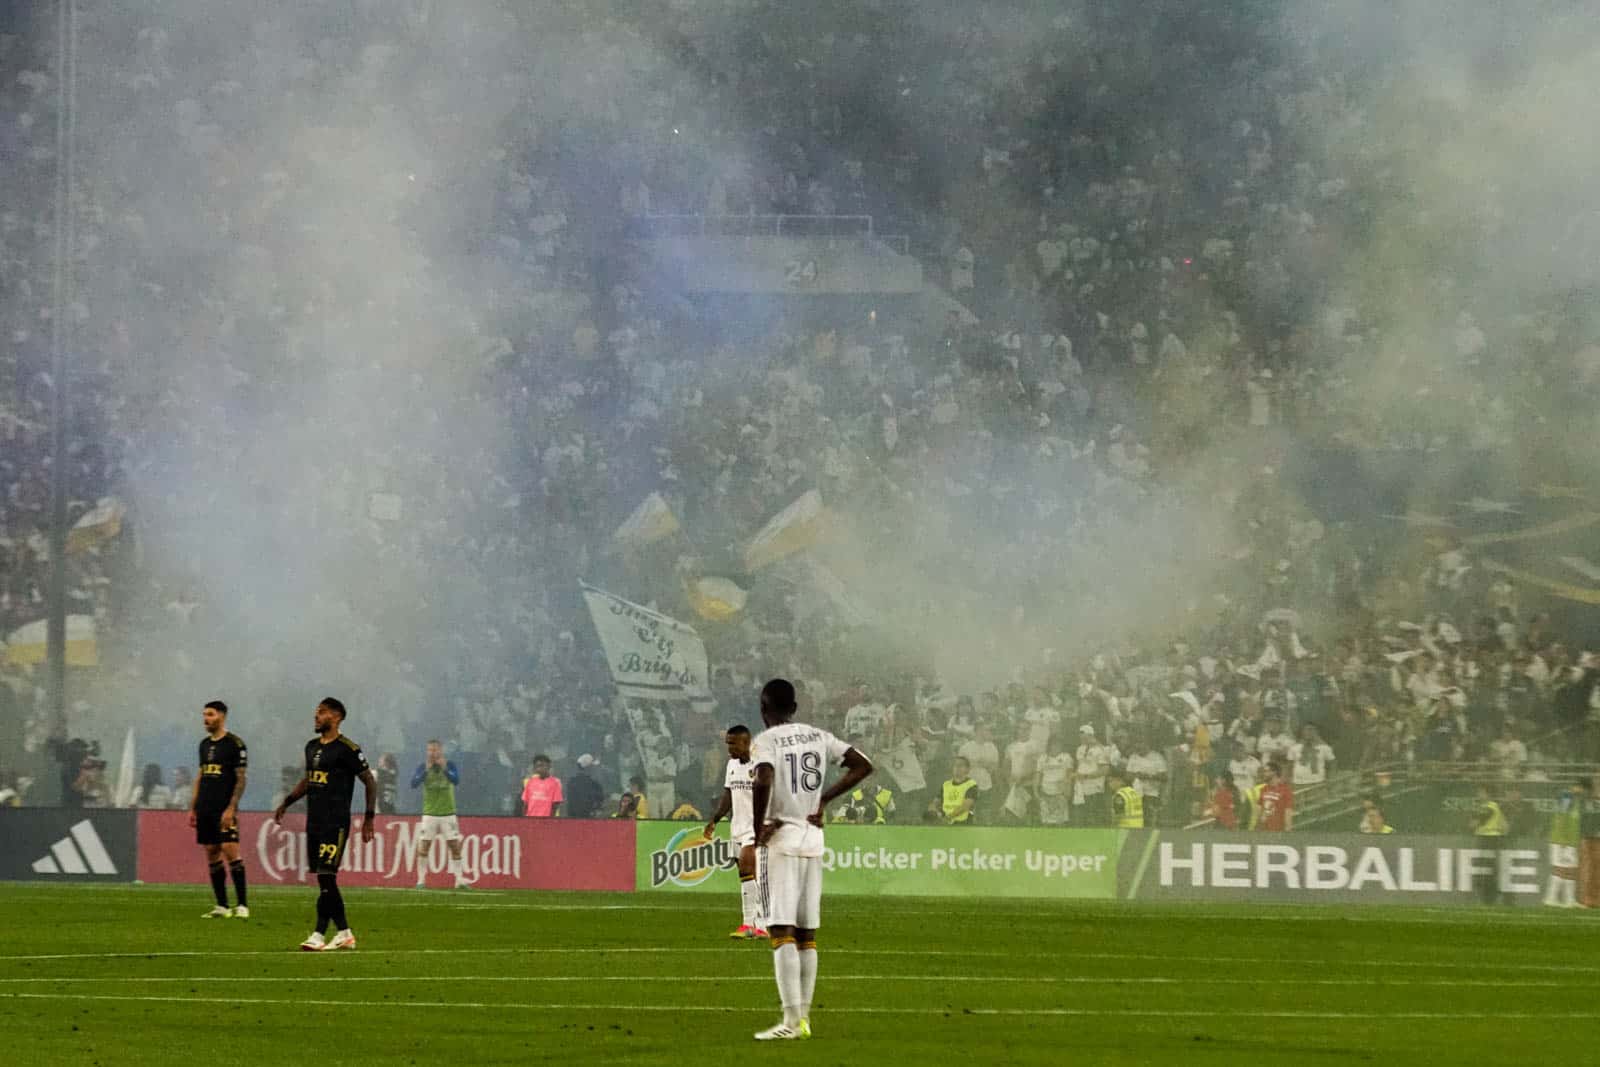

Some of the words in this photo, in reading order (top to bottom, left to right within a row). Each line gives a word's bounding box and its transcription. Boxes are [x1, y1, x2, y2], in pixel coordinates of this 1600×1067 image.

[785, 260, 817, 281] 24
[785, 751, 822, 794] 18
[651, 838, 740, 887] Bounty
[820, 846, 922, 871] Quicker
[931, 848, 1016, 870] Picker
[1025, 849, 1107, 877] Upper
[1160, 842, 1540, 893] HERBALIFE
